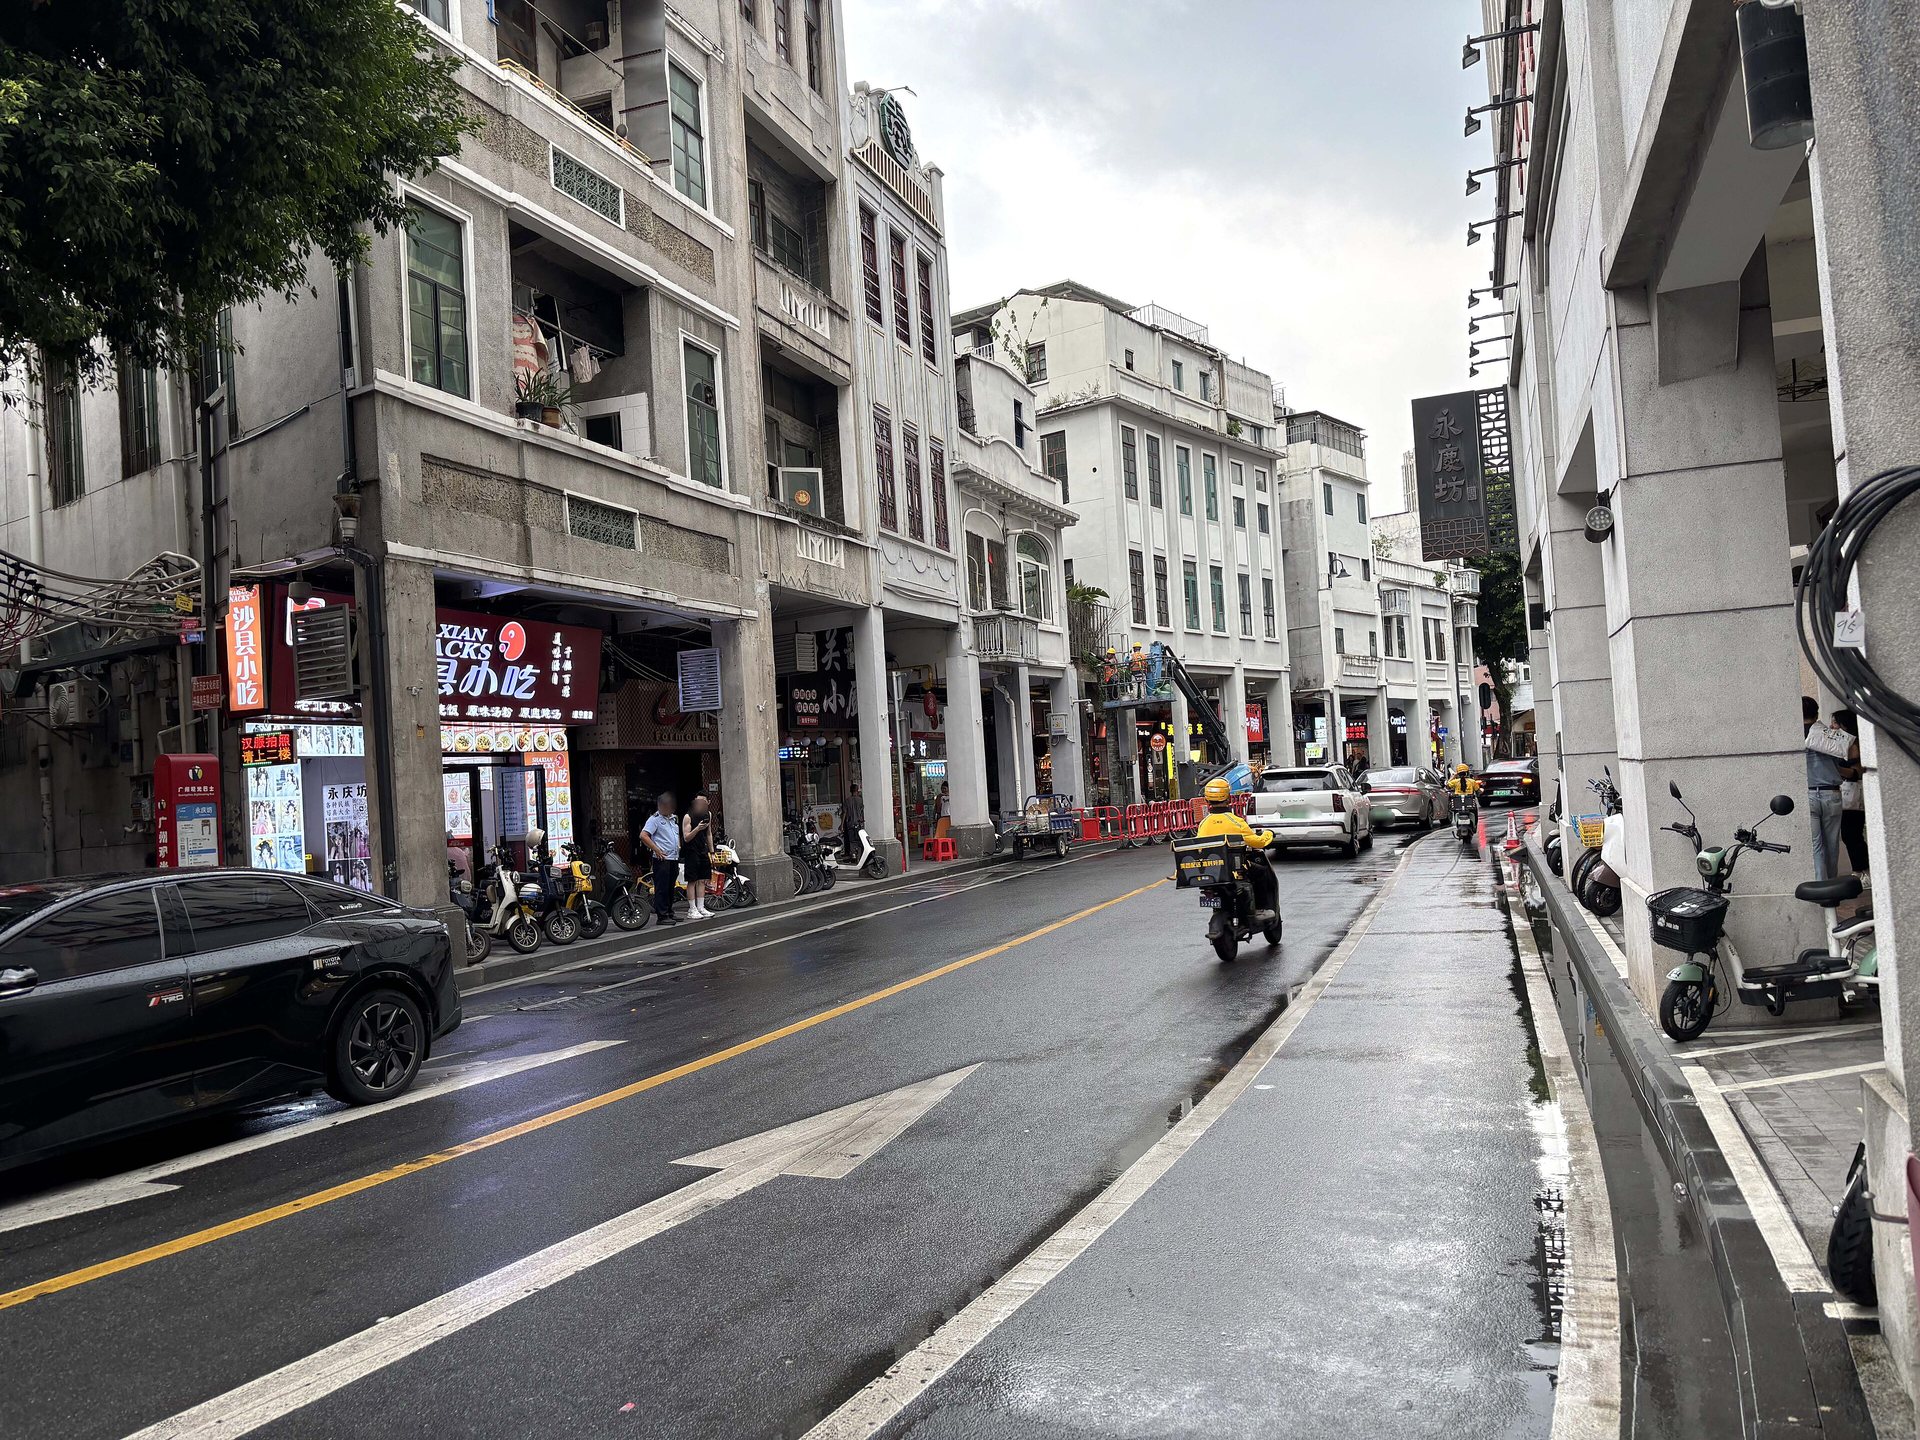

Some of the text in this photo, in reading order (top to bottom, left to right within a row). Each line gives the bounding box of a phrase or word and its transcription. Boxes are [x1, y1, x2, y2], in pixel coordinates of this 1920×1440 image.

[1428, 408, 1466, 503] 永慶坊
[1836, 619, 1857, 637] 95
[232, 605, 259, 705] 沙县小吃
[241, 733, 291, 750] 汉服拍照
[242, 746, 291, 764] 请上二楼
[527, 768, 568, 784] 沙小吃
[177, 785, 215, 793] 广州观光巴士
[327, 785, 367, 800] 永庆坊
[322, 955, 341, 964] TOYOTA
[161, 994, 184, 1003] TRD
